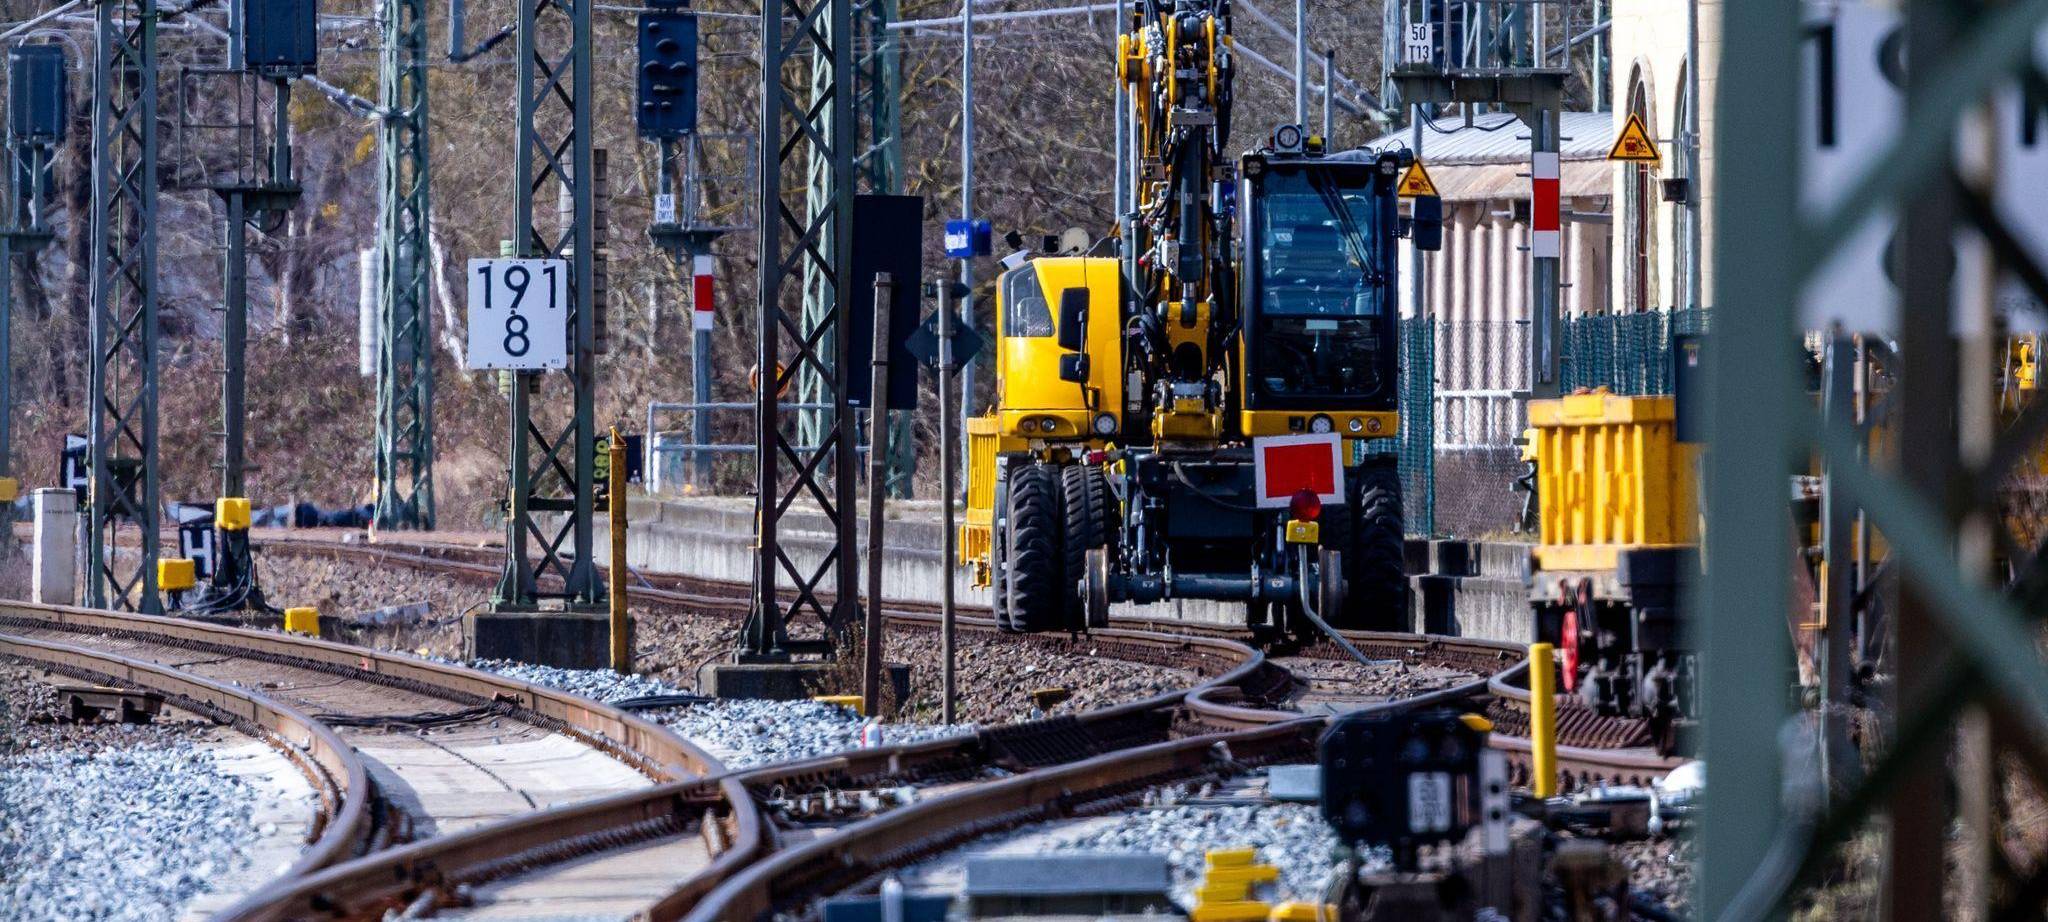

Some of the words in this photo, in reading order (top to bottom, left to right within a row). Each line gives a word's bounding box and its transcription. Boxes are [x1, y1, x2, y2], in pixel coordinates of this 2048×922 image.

[1411, 25, 1427, 41] 50
[1408, 45, 1429, 60] T13
[477, 265, 557, 309] 191
[503, 314, 531, 358] 8
